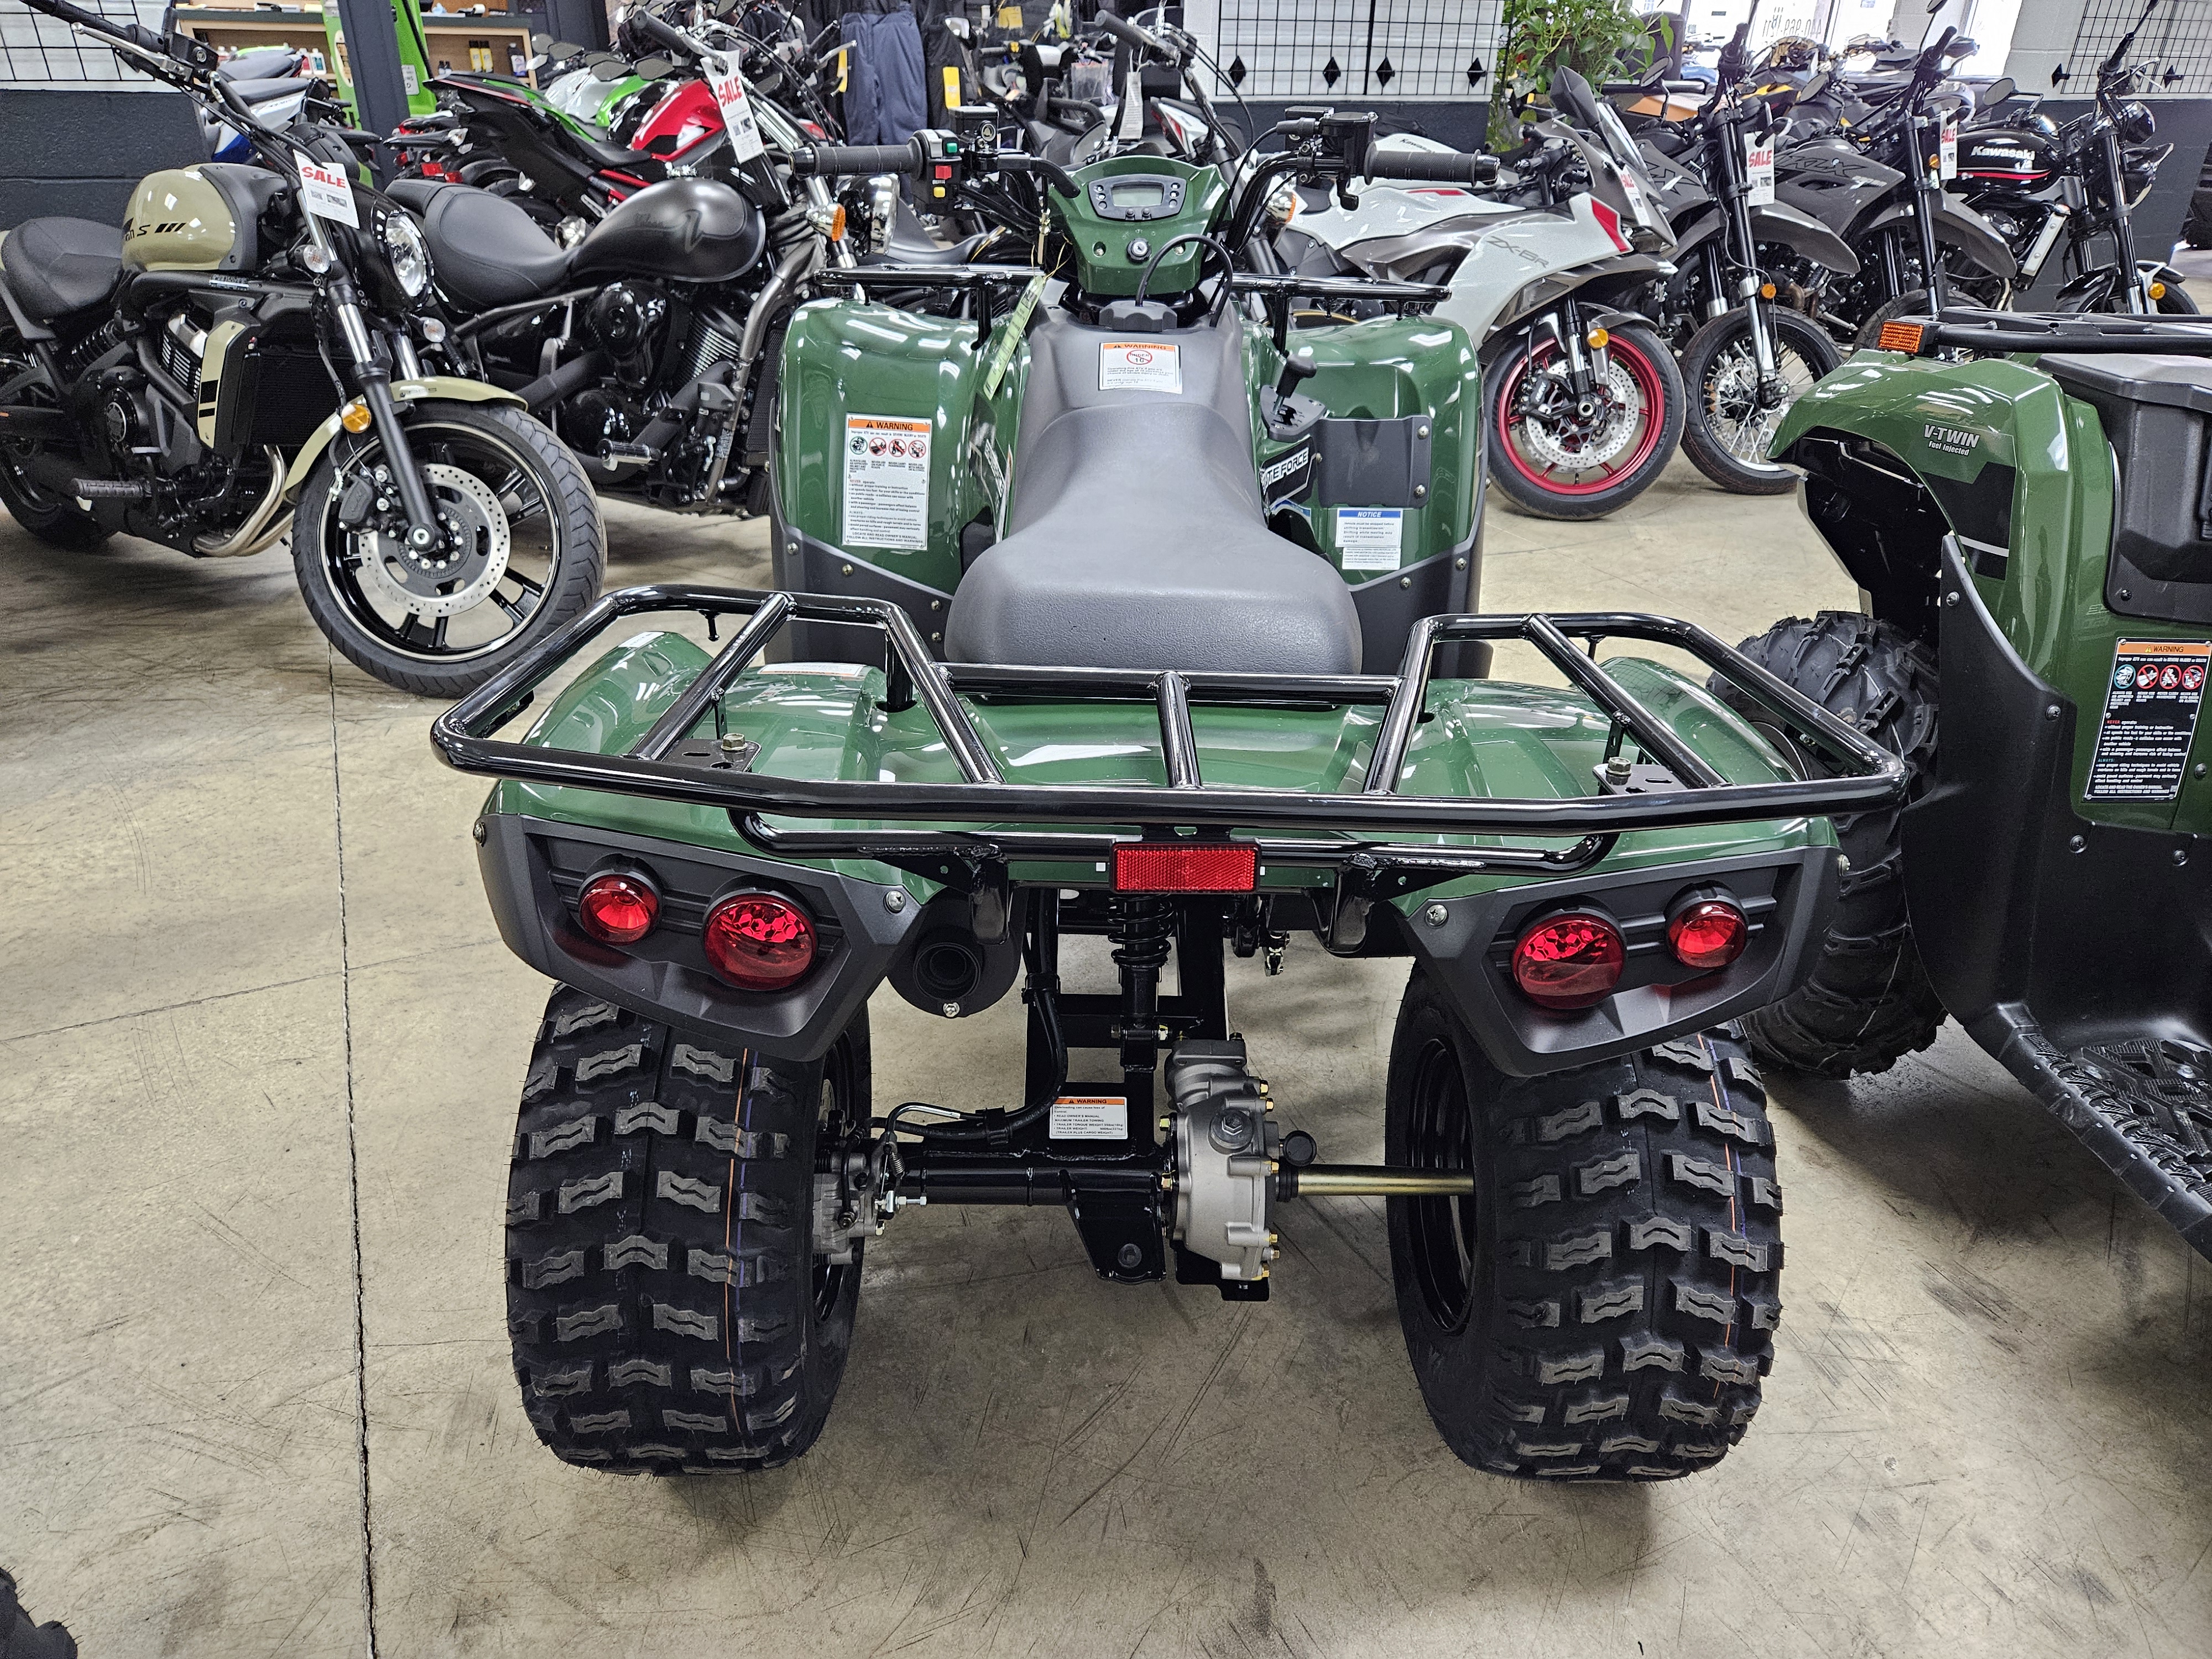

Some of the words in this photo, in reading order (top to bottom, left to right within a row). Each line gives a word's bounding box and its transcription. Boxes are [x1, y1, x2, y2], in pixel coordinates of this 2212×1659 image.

[718, 76, 742, 108] SALE
[1942, 128, 1955, 144] SALE
[1749, 150, 1772, 168] SALE
[1971, 146, 2035, 160] Kawasaki
[302, 166, 346, 189] SALE
[877, 422, 912, 430] WARNING
[1924, 424, 1980, 448] V-TWIN
[1928, 441, 1942, 450] Fuel
[1943, 444, 1969, 456] Injected
[1280, 448, 1308, 477] FORCE
